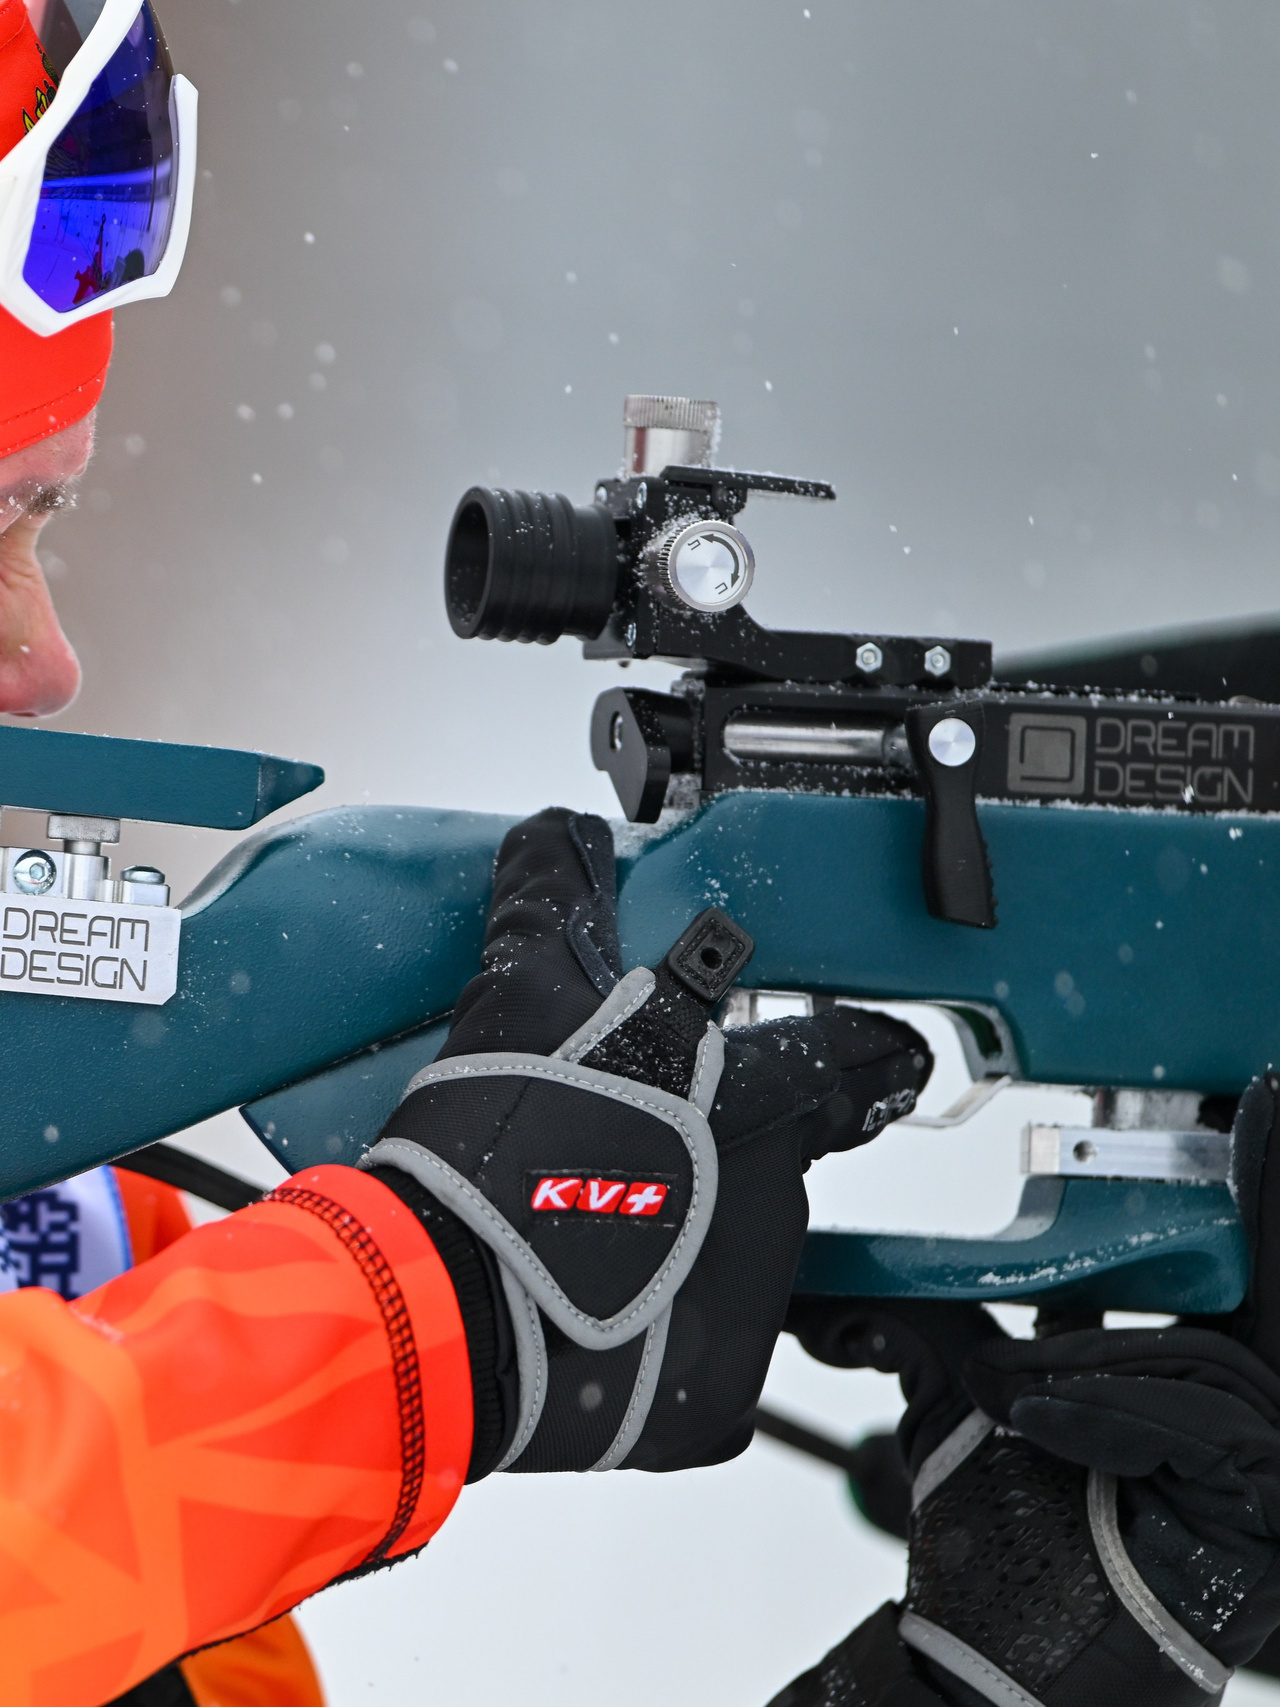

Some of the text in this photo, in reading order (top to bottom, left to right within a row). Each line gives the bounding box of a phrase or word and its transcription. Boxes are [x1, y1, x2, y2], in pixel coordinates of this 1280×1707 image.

[1095, 717, 1255, 762] DREAM
[1093, 760, 1254, 804] DESIGN
[2, 906, 150, 952] DREAM
[0, 946, 148, 992] DESIGN
